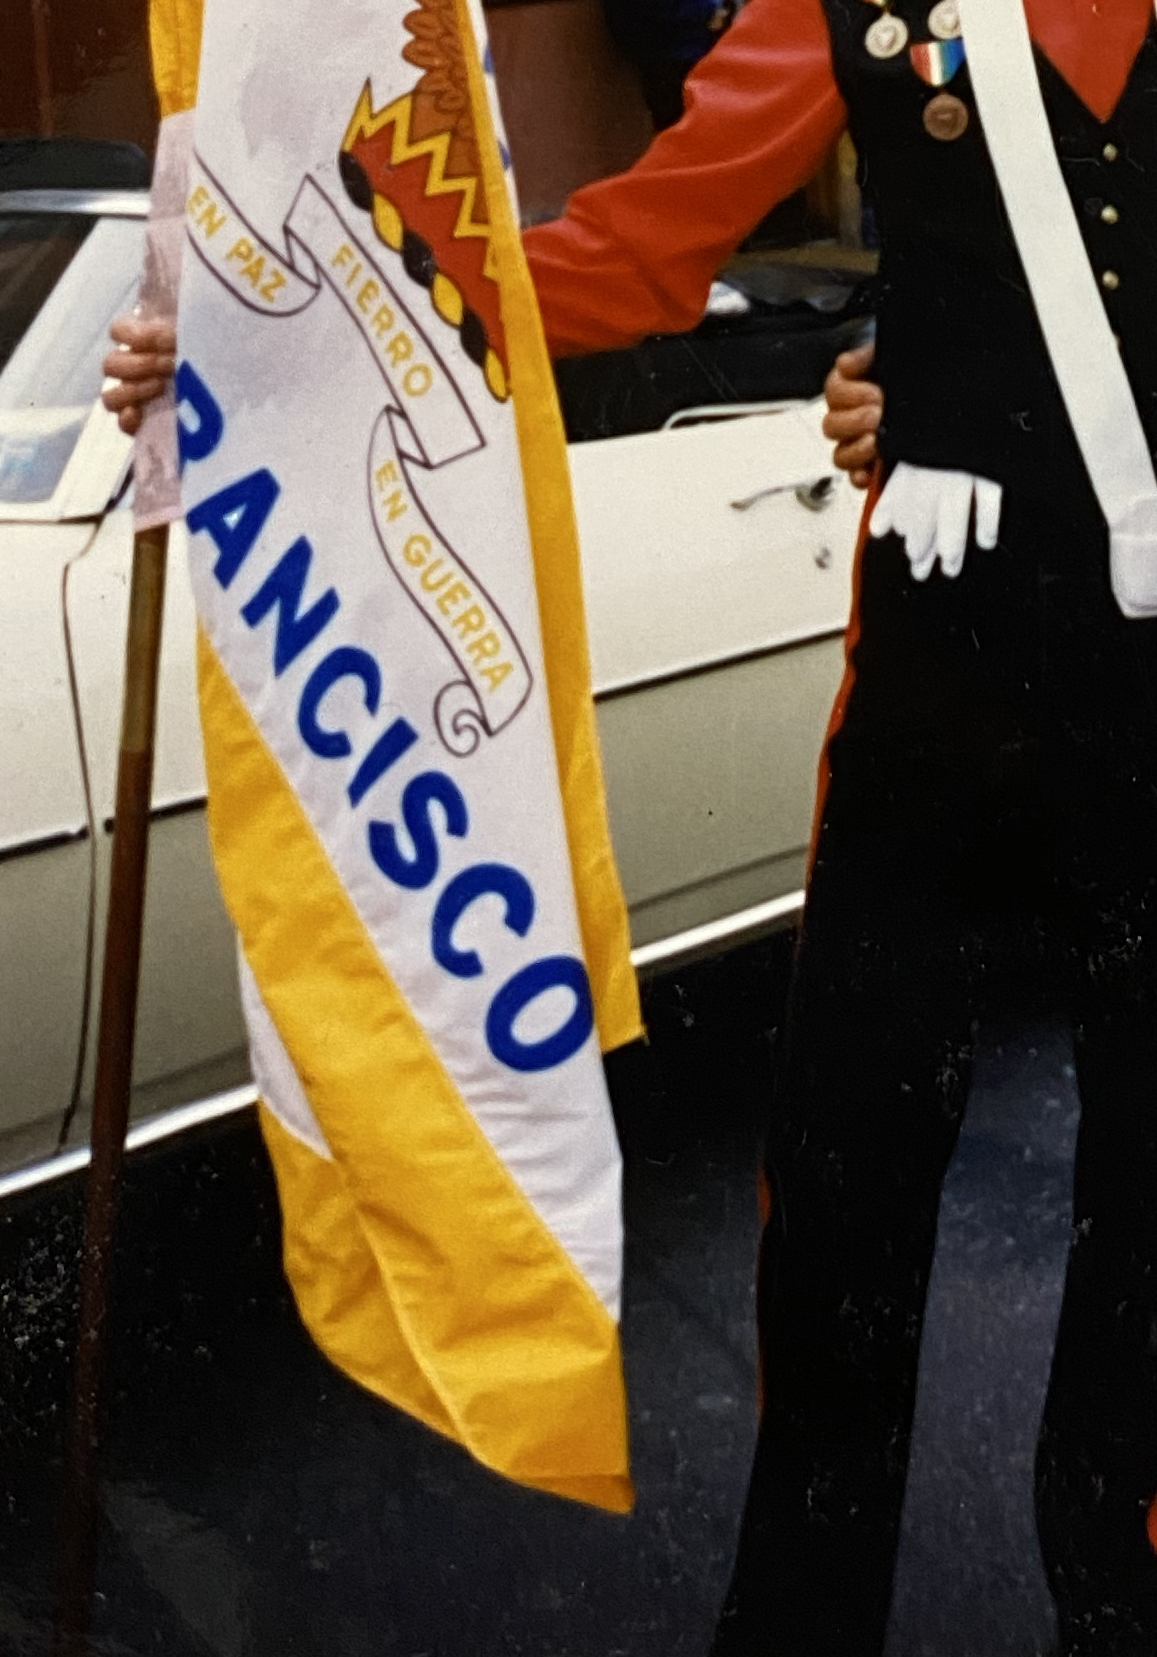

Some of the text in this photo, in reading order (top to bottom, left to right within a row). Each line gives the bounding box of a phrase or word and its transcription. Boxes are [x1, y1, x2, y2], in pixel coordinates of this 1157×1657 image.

[186, 184, 288, 304] EN PAZ
[331, 246, 434, 398] FIERRO
[374, 459, 515, 694] EN GUERRA
